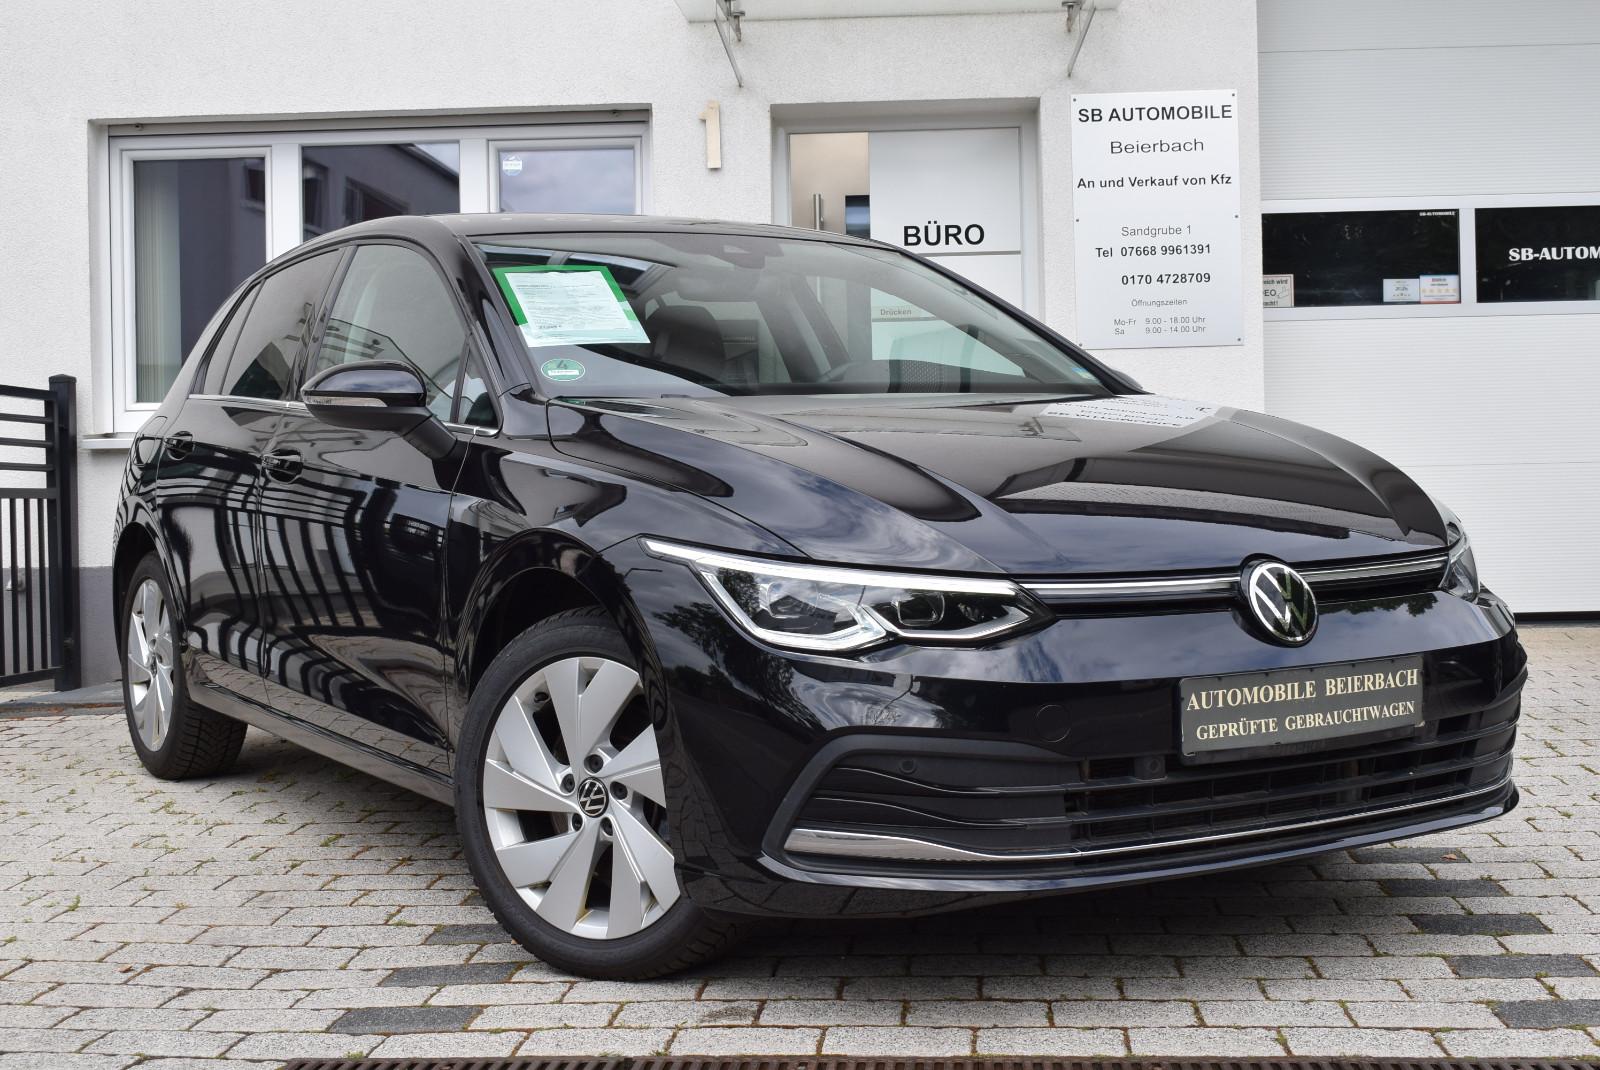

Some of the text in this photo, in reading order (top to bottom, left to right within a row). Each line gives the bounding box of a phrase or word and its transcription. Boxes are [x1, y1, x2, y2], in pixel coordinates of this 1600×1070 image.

[1078, 104, 1233, 122] SB AUTOMOBILE
[699, 99, 722, 170] 1
[1110, 138, 1204, 155] Beierbach
[1077, 173, 1233, 189] An und Verkauf von Kfz
[903, 220, 985, 247] BÜRO
[1121, 225, 1192, 238] Sandgrube 1
[1095, 244, 1212, 258] Tel 07668 9961391
[1121, 272, 1212, 285] 0170 4728709
[1131, 298, 1188, 308] Öffnungszeiten
[880, 307, 912, 316] Drücken
[1113, 318, 1136, 326] Mo-Fr
[1145, 317, 1162, 325] 9.00
[1169, 316, 1190, 324] 18.00
[1192, 316, 1206, 324] Uhr
[1145, 326, 1162, 334] 9.00
[1170, 325, 1190, 333] 14.00
[1192, 325, 1206, 333] Uhr
[1187, 668, 1419, 711] AUTOMOBILE BEIERBACH
[1196, 700, 1416, 741] GEPRÜFTE GEBRAUCHTWAGEN
